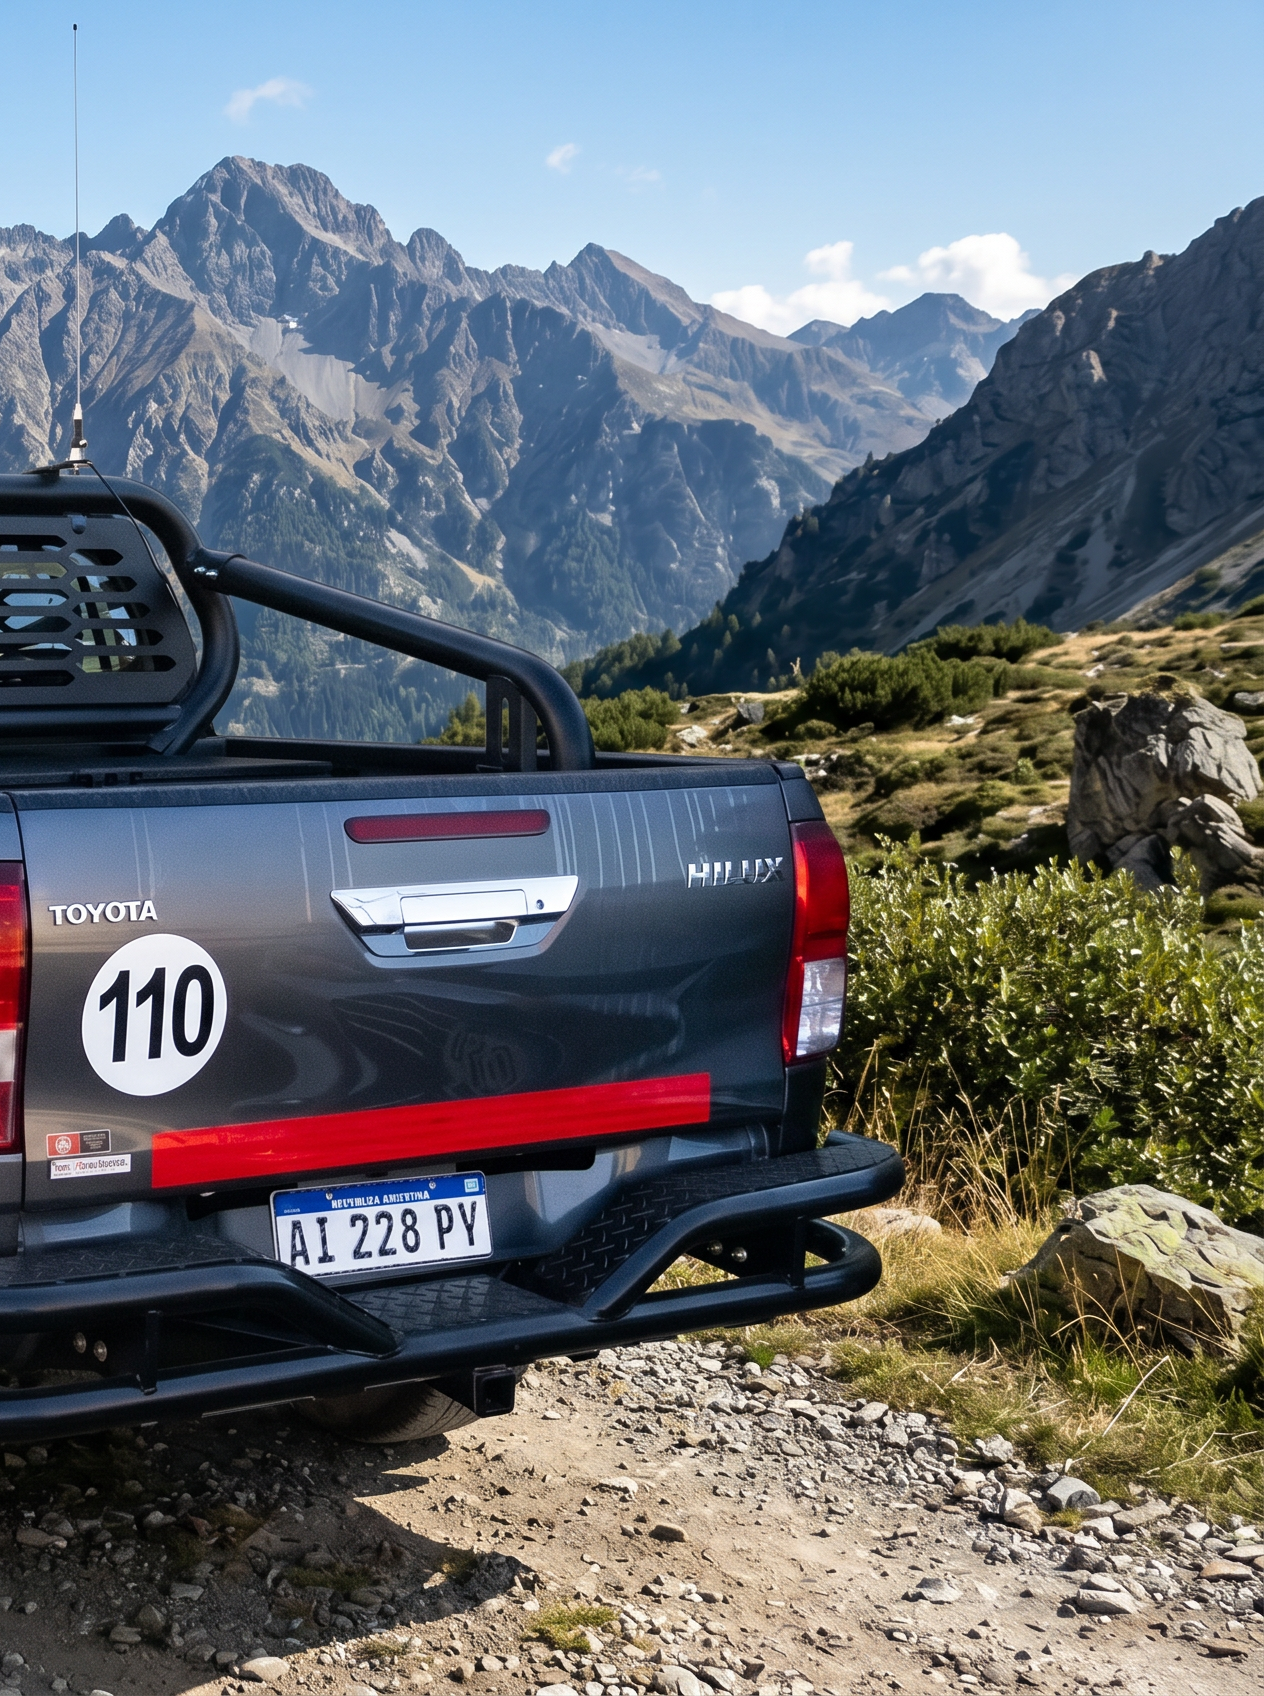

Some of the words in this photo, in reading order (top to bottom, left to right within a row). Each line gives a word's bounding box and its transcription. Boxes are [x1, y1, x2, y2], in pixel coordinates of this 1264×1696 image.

[688, 857, 783, 888] HILUX
[49, 900, 158, 925] TOYOTA
[99, 964, 214, 1063] 110
[290, 1217, 335, 1267] AI
[350, 1208, 421, 1259] 228
[433, 1200, 477, 1250] PY
